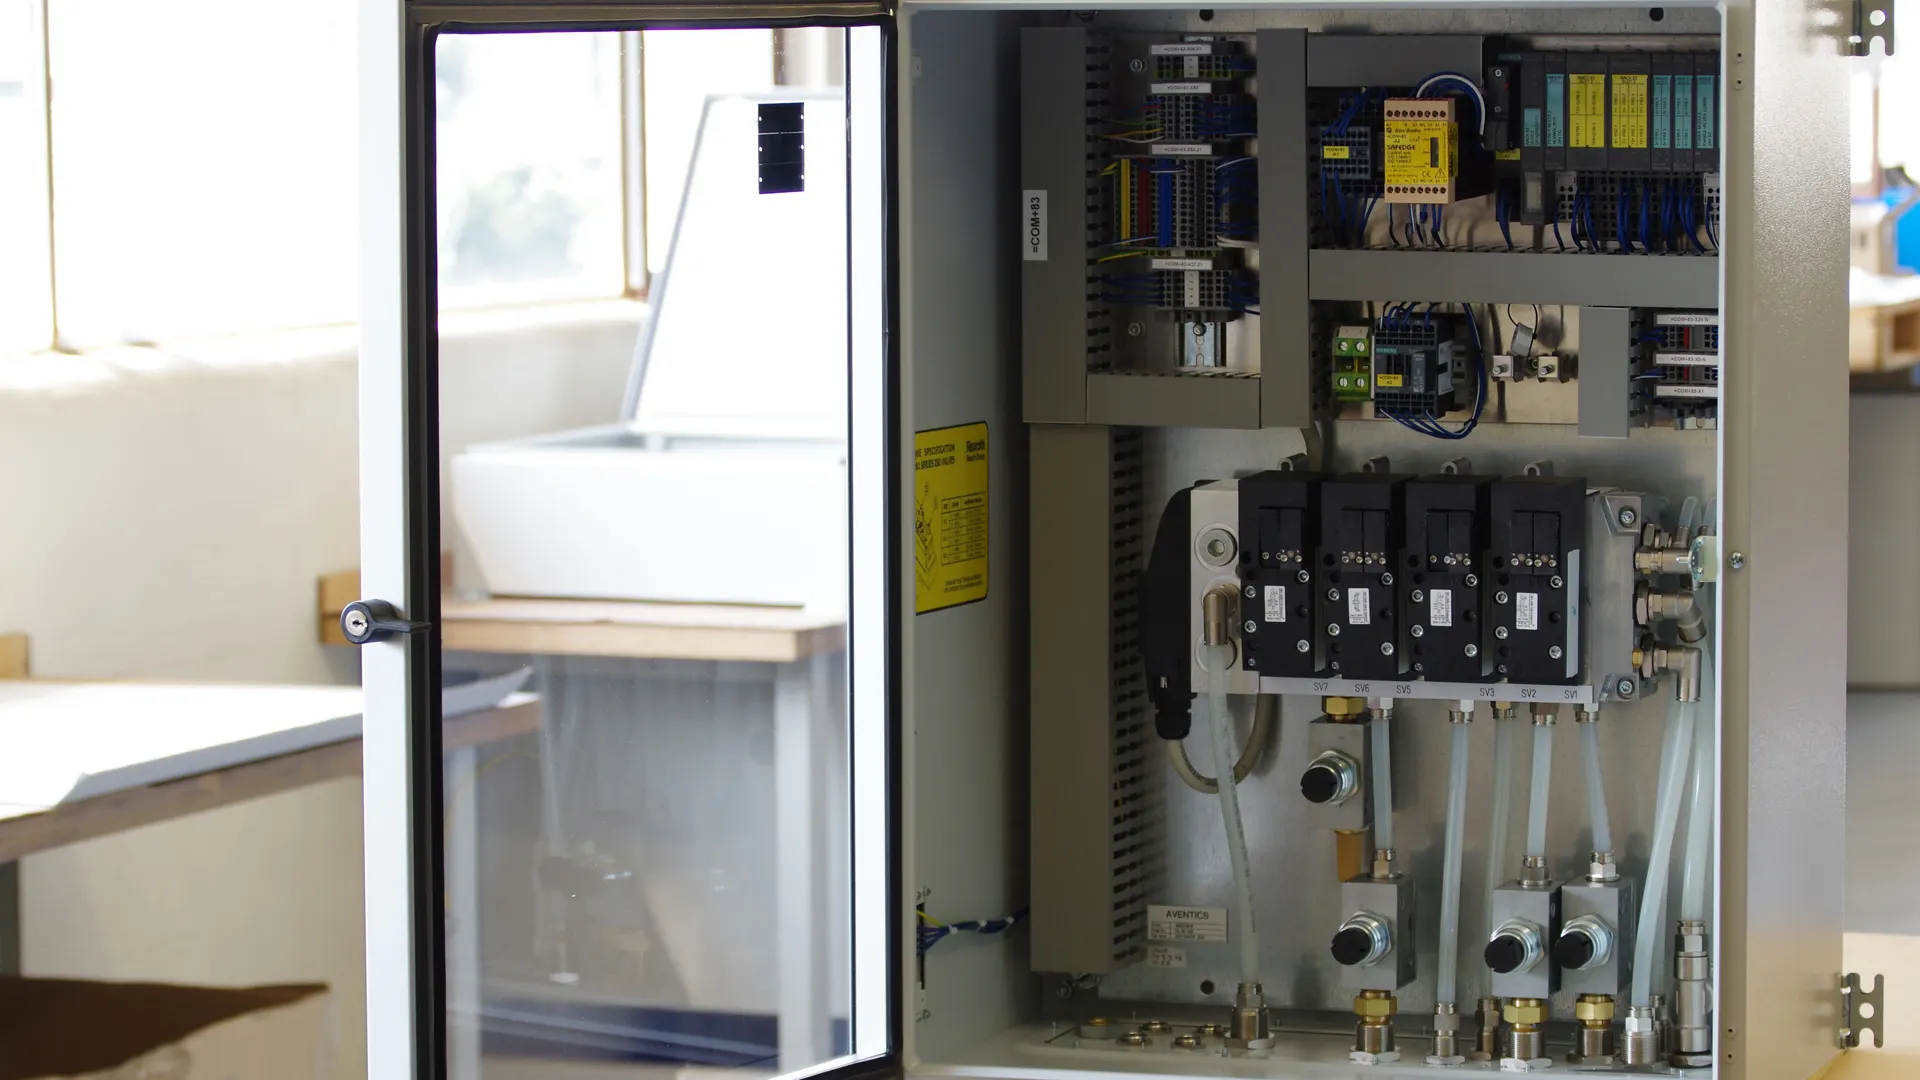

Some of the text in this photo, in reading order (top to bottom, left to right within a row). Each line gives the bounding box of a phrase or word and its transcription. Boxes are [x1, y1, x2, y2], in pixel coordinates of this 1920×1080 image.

[1030, 196, 1040, 253] =COM+83
[1313, 682, 1329, 691] SV7
[1354, 683, 1370, 693] SV6
[1396, 685, 1412, 694] SV5
[1479, 687, 1495, 697] SV3
[1521, 688, 1537, 698] SV2
[1564, 690, 1578, 699] SV1
[1166, 910, 1209, 920] AVENTICS
